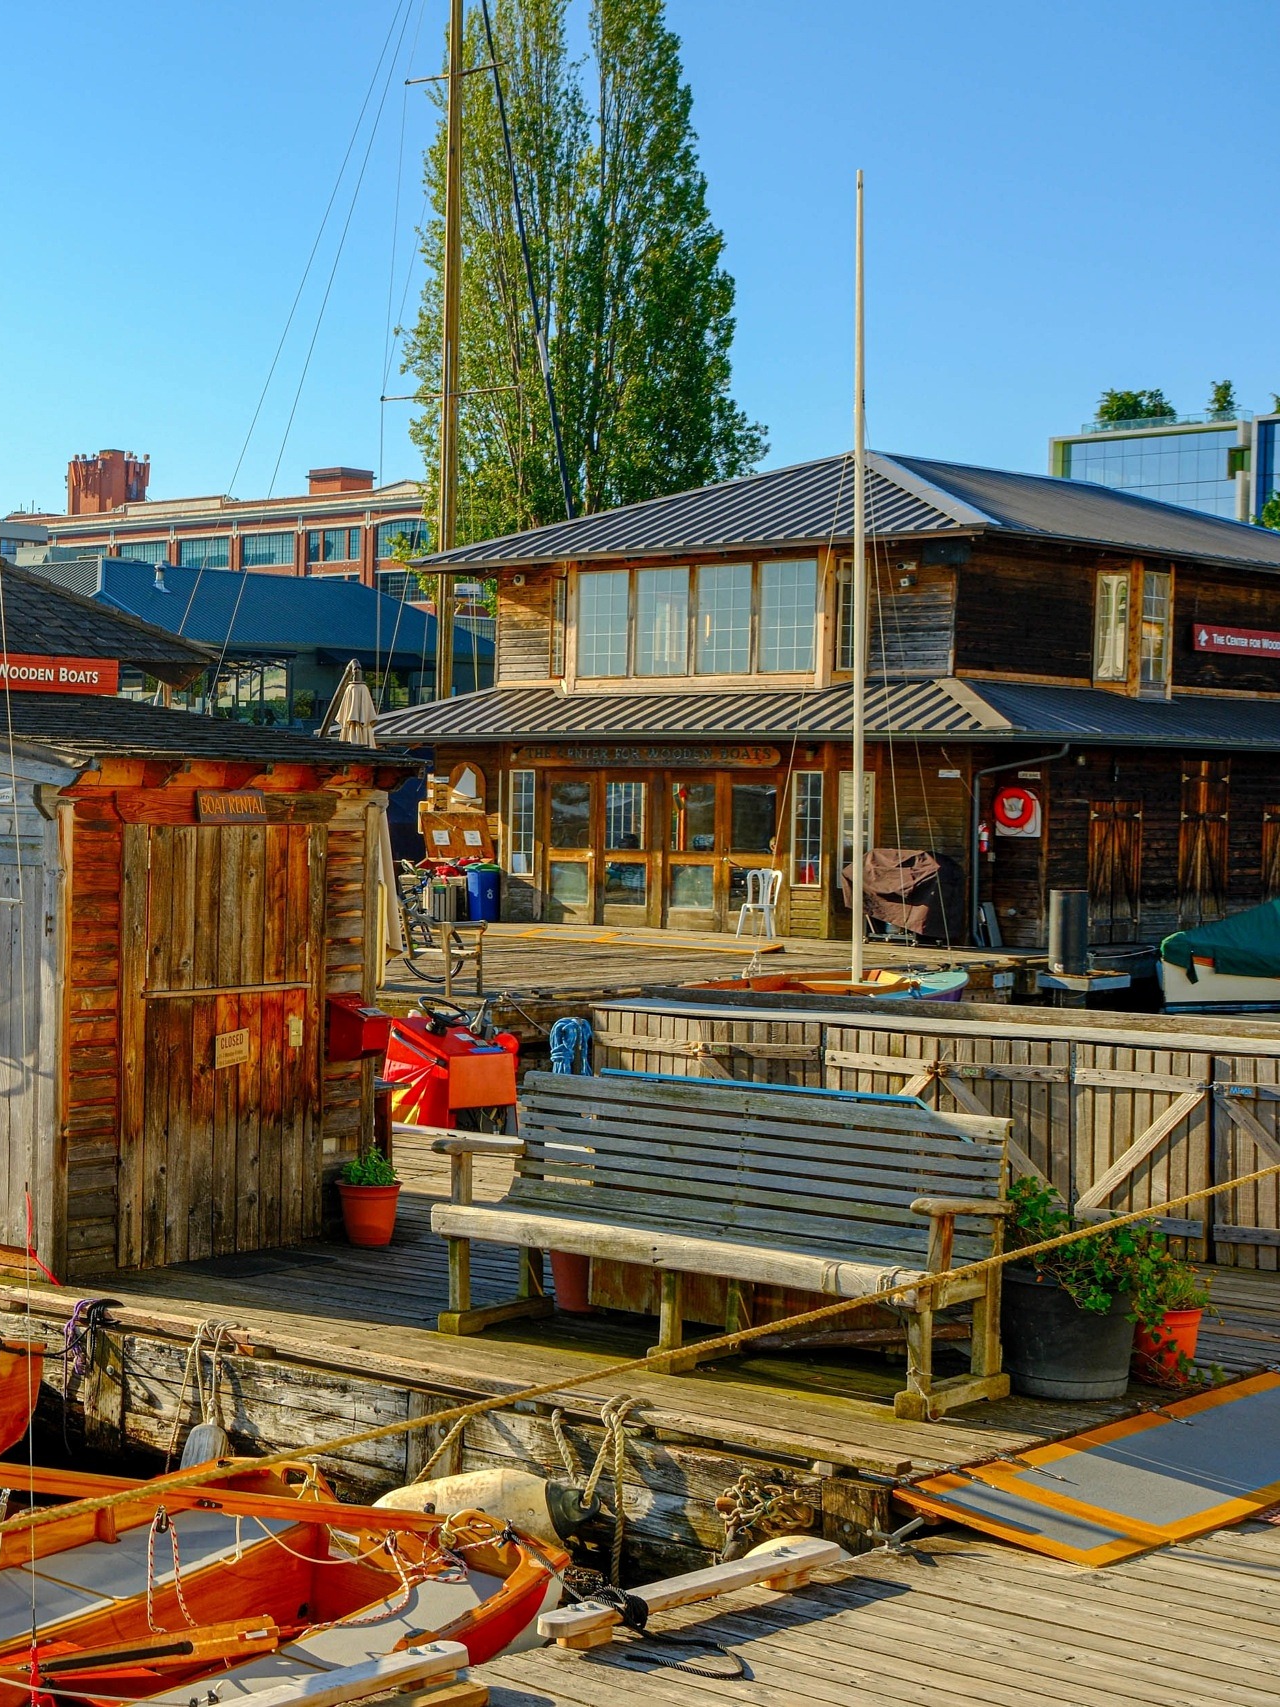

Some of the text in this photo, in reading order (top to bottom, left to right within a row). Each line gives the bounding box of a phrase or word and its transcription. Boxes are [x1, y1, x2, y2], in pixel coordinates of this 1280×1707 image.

[59, 667, 100, 684] BOATS
[200, 796, 266, 814] BOAT RENTAL
[220, 1033, 244, 1050] CLOSED
